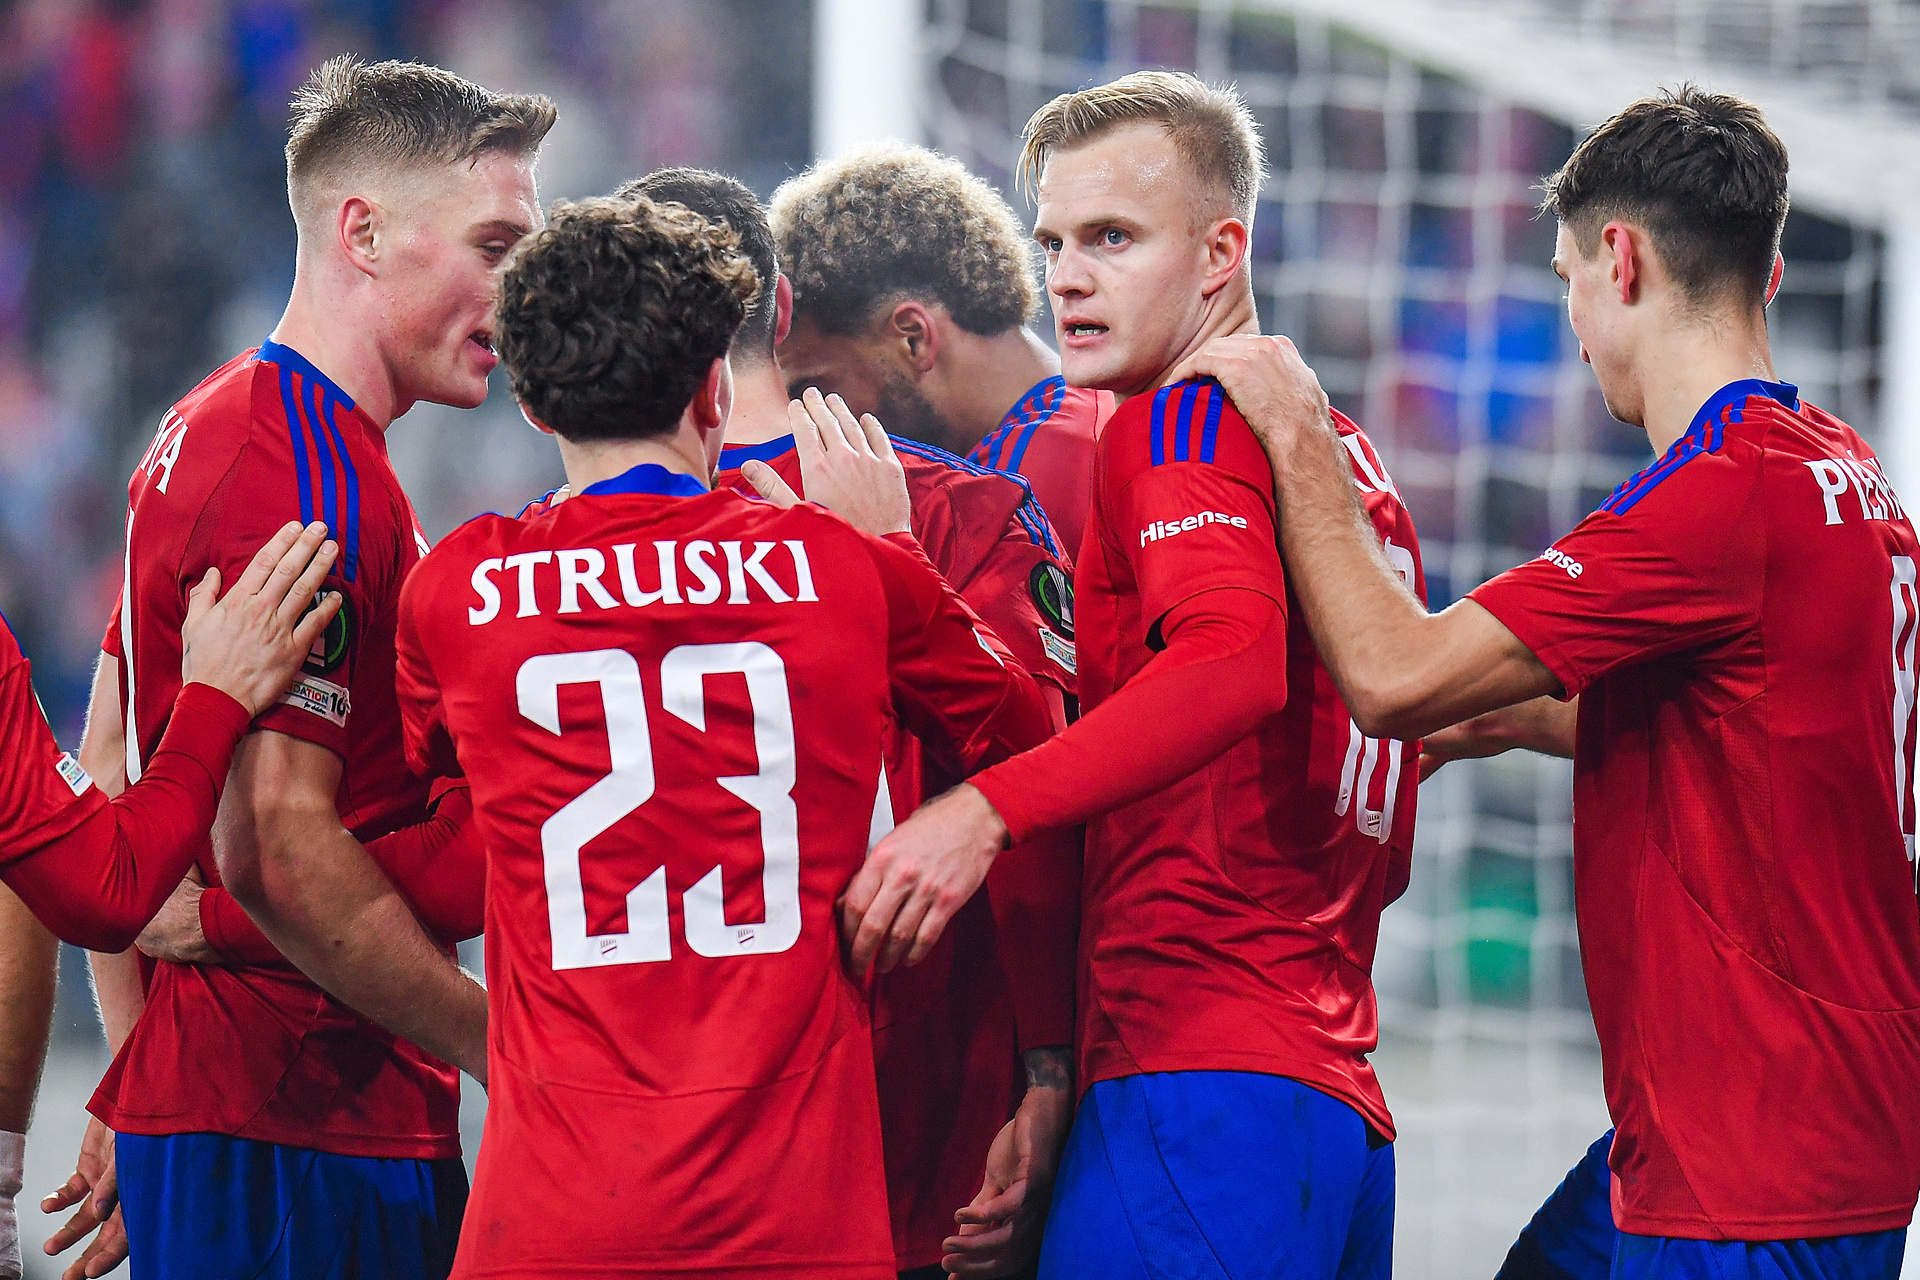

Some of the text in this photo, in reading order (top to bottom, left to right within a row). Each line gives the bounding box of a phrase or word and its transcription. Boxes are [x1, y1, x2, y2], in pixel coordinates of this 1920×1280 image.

[1140, 510, 1248, 548] Hisense
[469, 540, 819, 625] STRUSKI
[516, 641, 802, 970] 23
